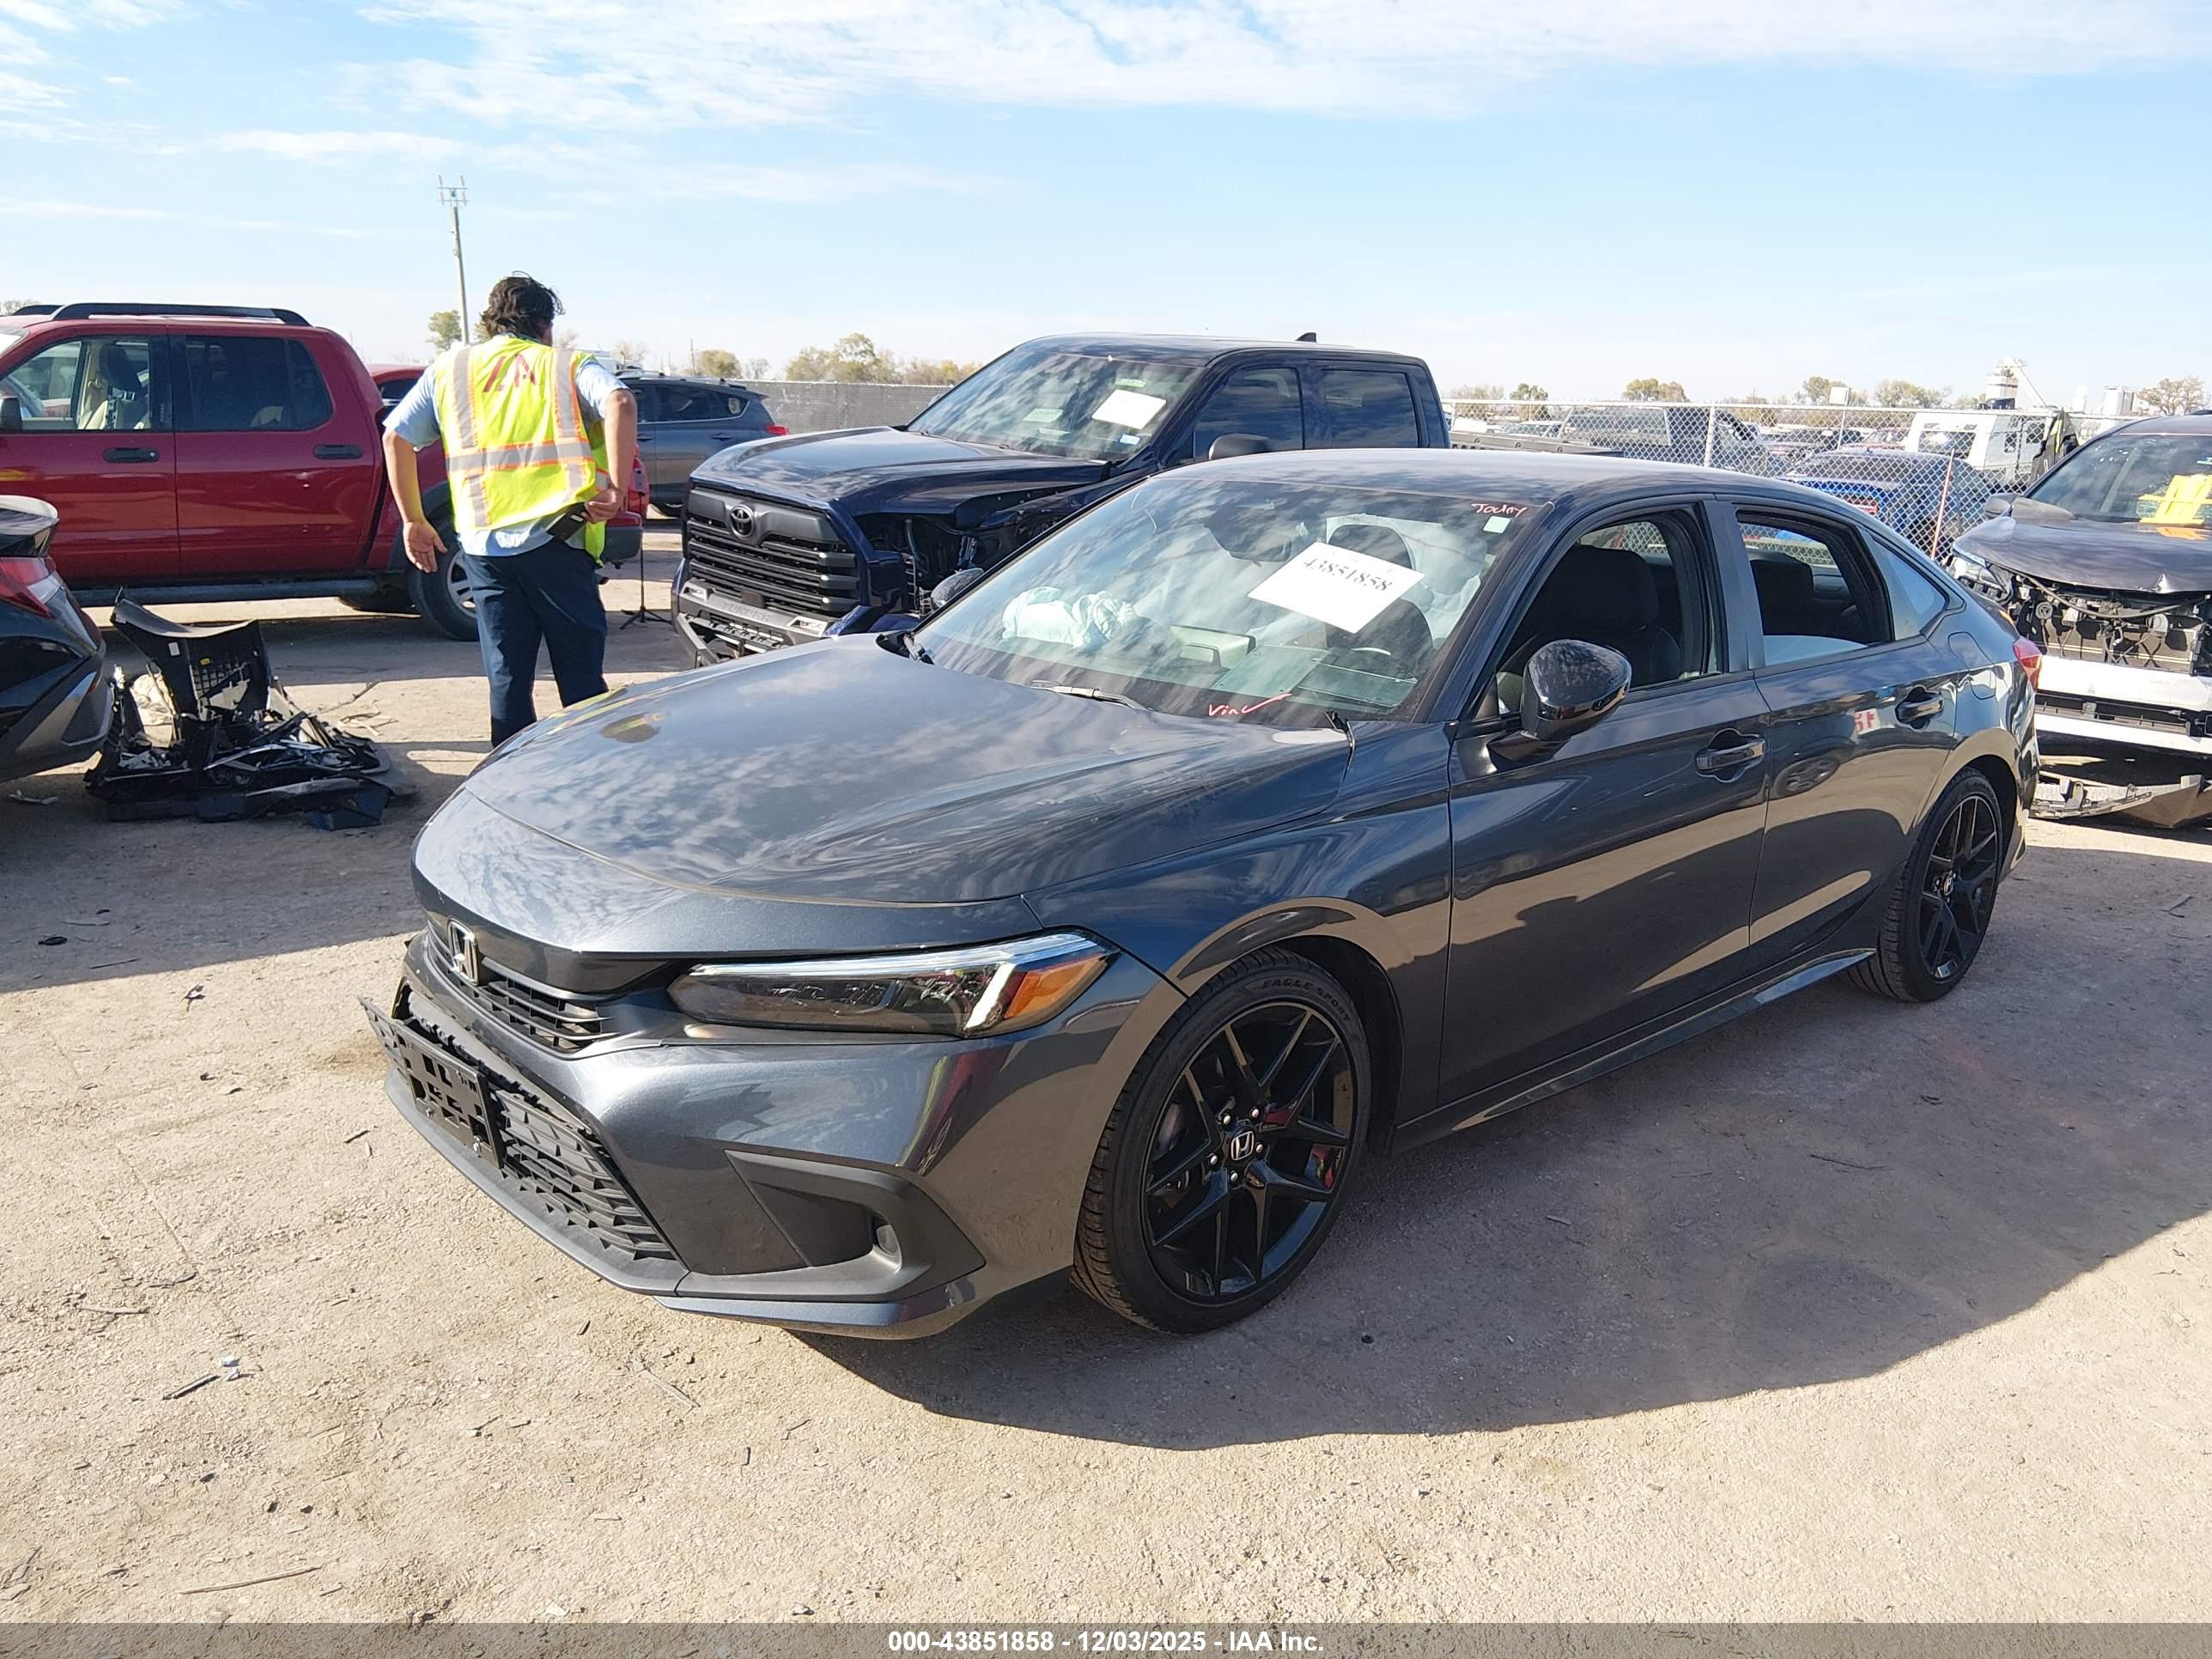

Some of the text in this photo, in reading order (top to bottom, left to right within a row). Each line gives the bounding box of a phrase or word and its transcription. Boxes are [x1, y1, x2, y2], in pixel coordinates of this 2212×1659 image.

[1303, 557, 1393, 592] 43851858
[1261, 977, 1352, 1022] EAGLE SPORT
